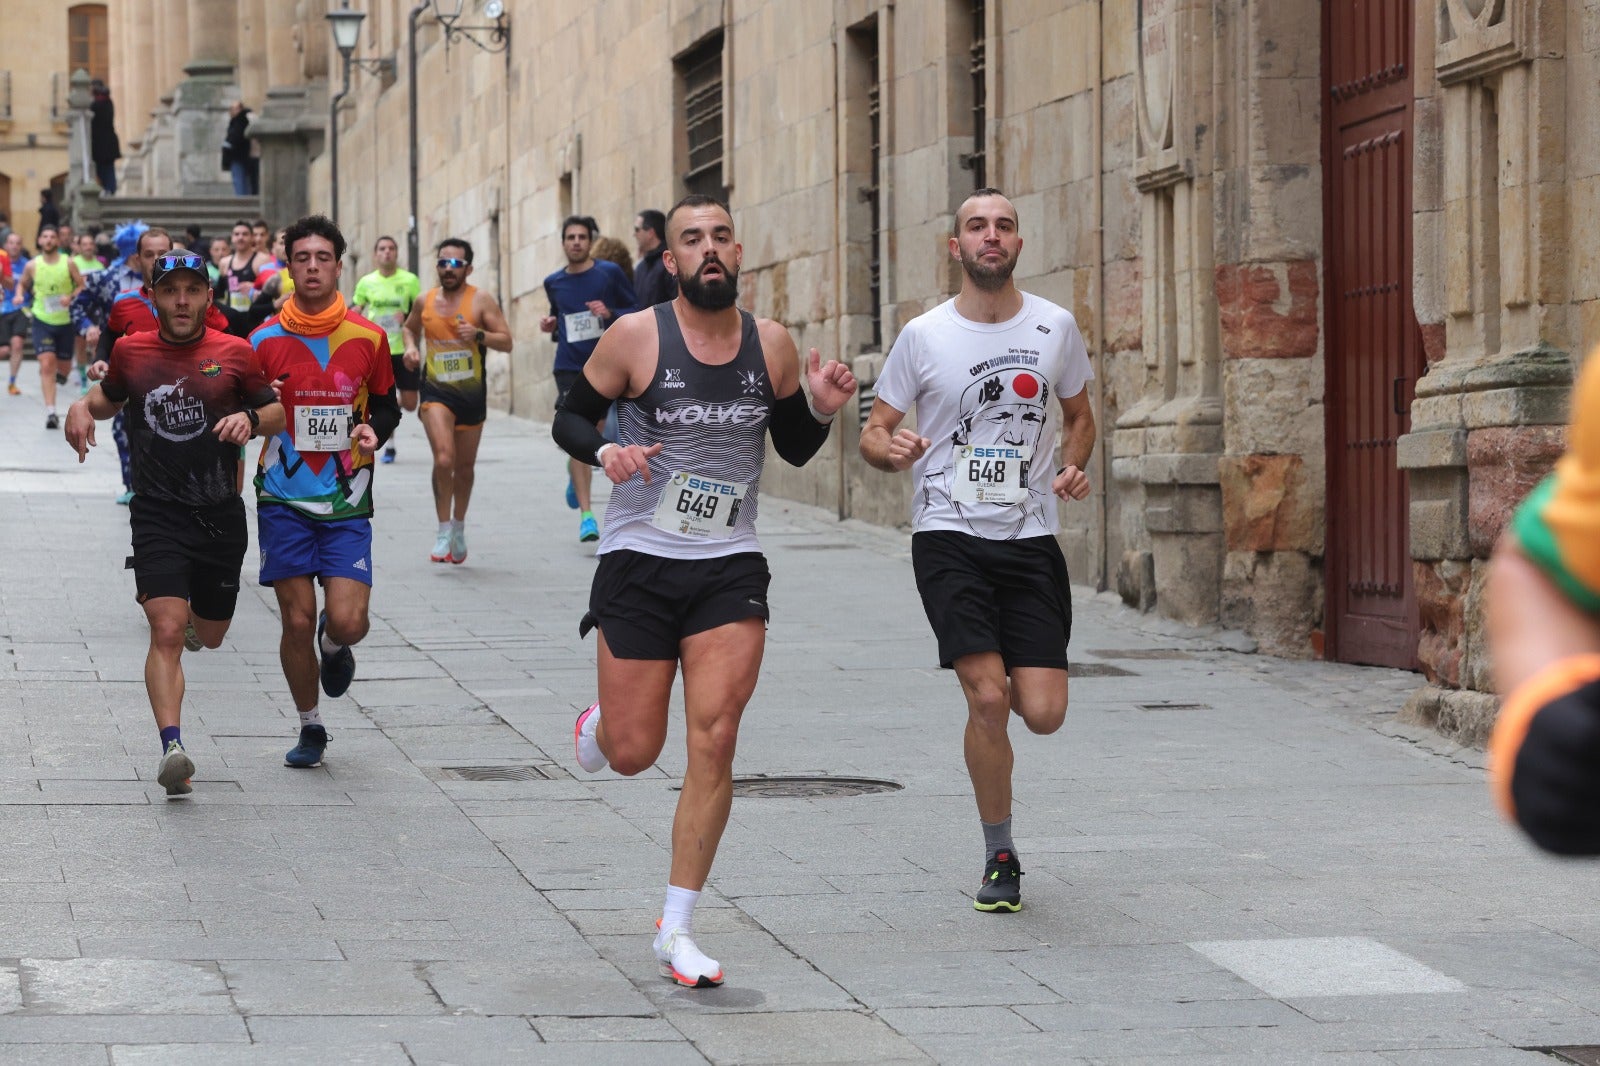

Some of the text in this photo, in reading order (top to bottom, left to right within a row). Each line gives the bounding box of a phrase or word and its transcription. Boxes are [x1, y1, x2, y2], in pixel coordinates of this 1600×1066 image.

[443, 359, 460, 372] 188
[969, 354, 1039, 377] CAPI'S RUNNING TEAM
[311, 408, 348, 416] SETEL
[655, 404, 768, 426] WOLVES
[308, 418, 338, 436] 844
[974, 447, 1024, 459] SETEL
[968, 459, 1006, 483] 648
[688, 478, 738, 496] SETEL
[676, 488, 719, 519] 649
